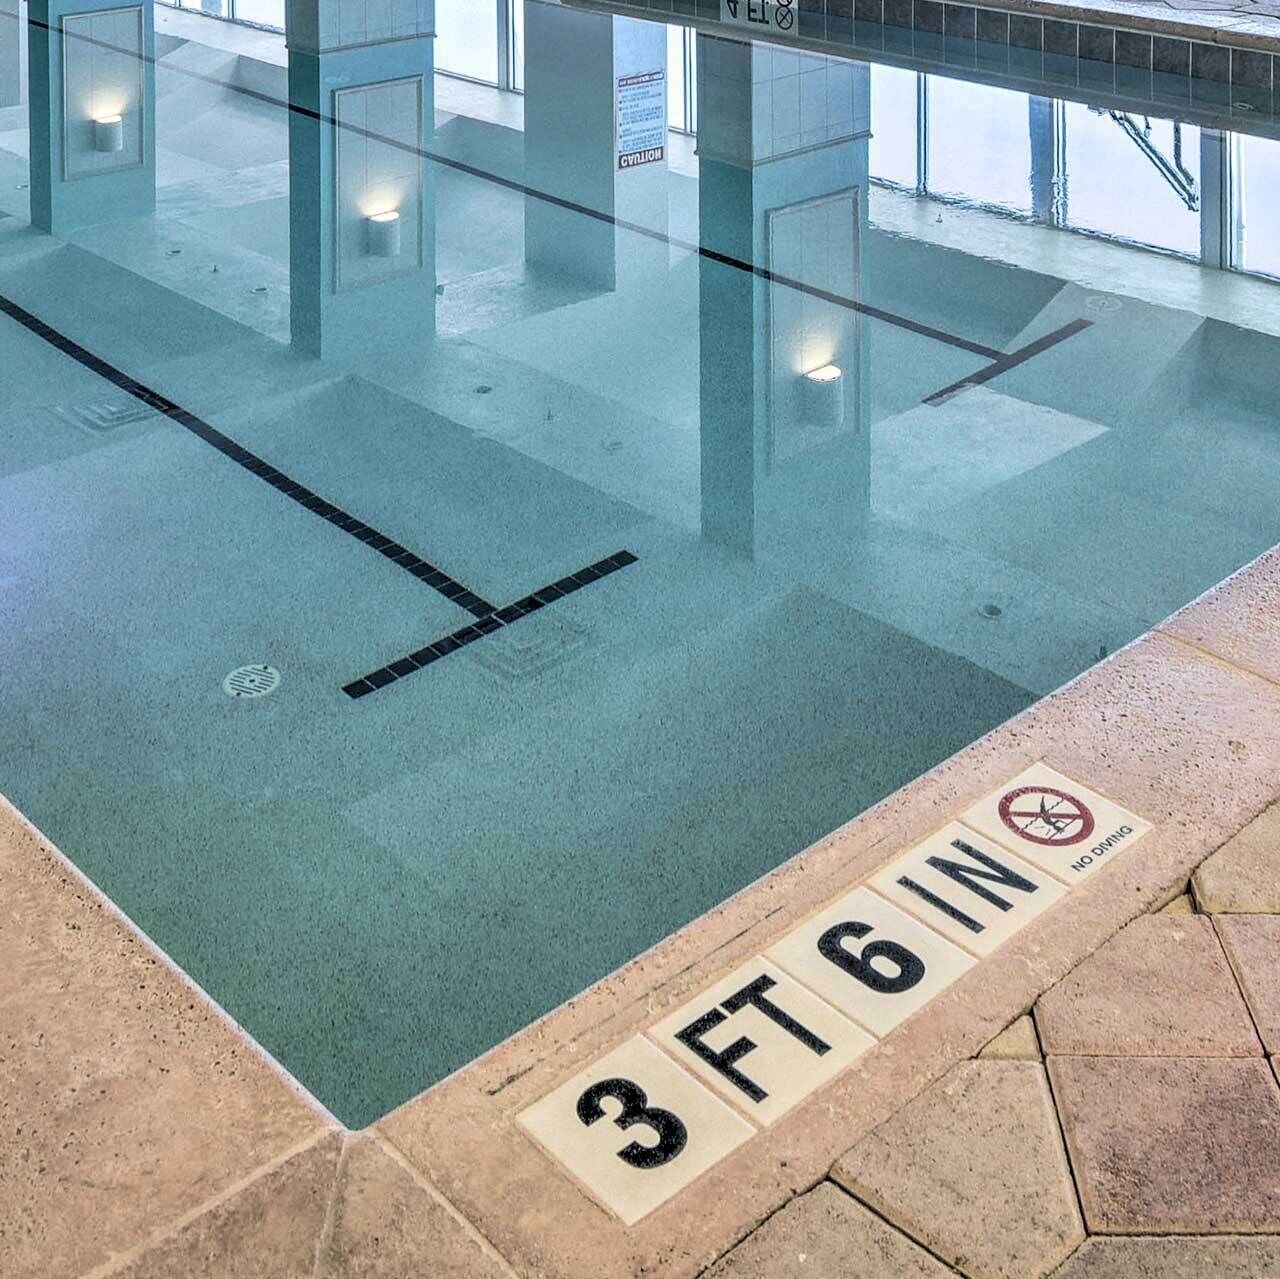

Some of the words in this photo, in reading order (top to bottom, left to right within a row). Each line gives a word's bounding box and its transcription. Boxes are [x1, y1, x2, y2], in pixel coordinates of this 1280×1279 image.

[1069, 855, 1094, 874] NO
[1090, 825, 1134, 857] DIVING
[575, 1076, 689, 1171] 3
[673, 973, 833, 1105] FT
[816, 920, 927, 995] 6
[896, 837, 1040, 935] IN
